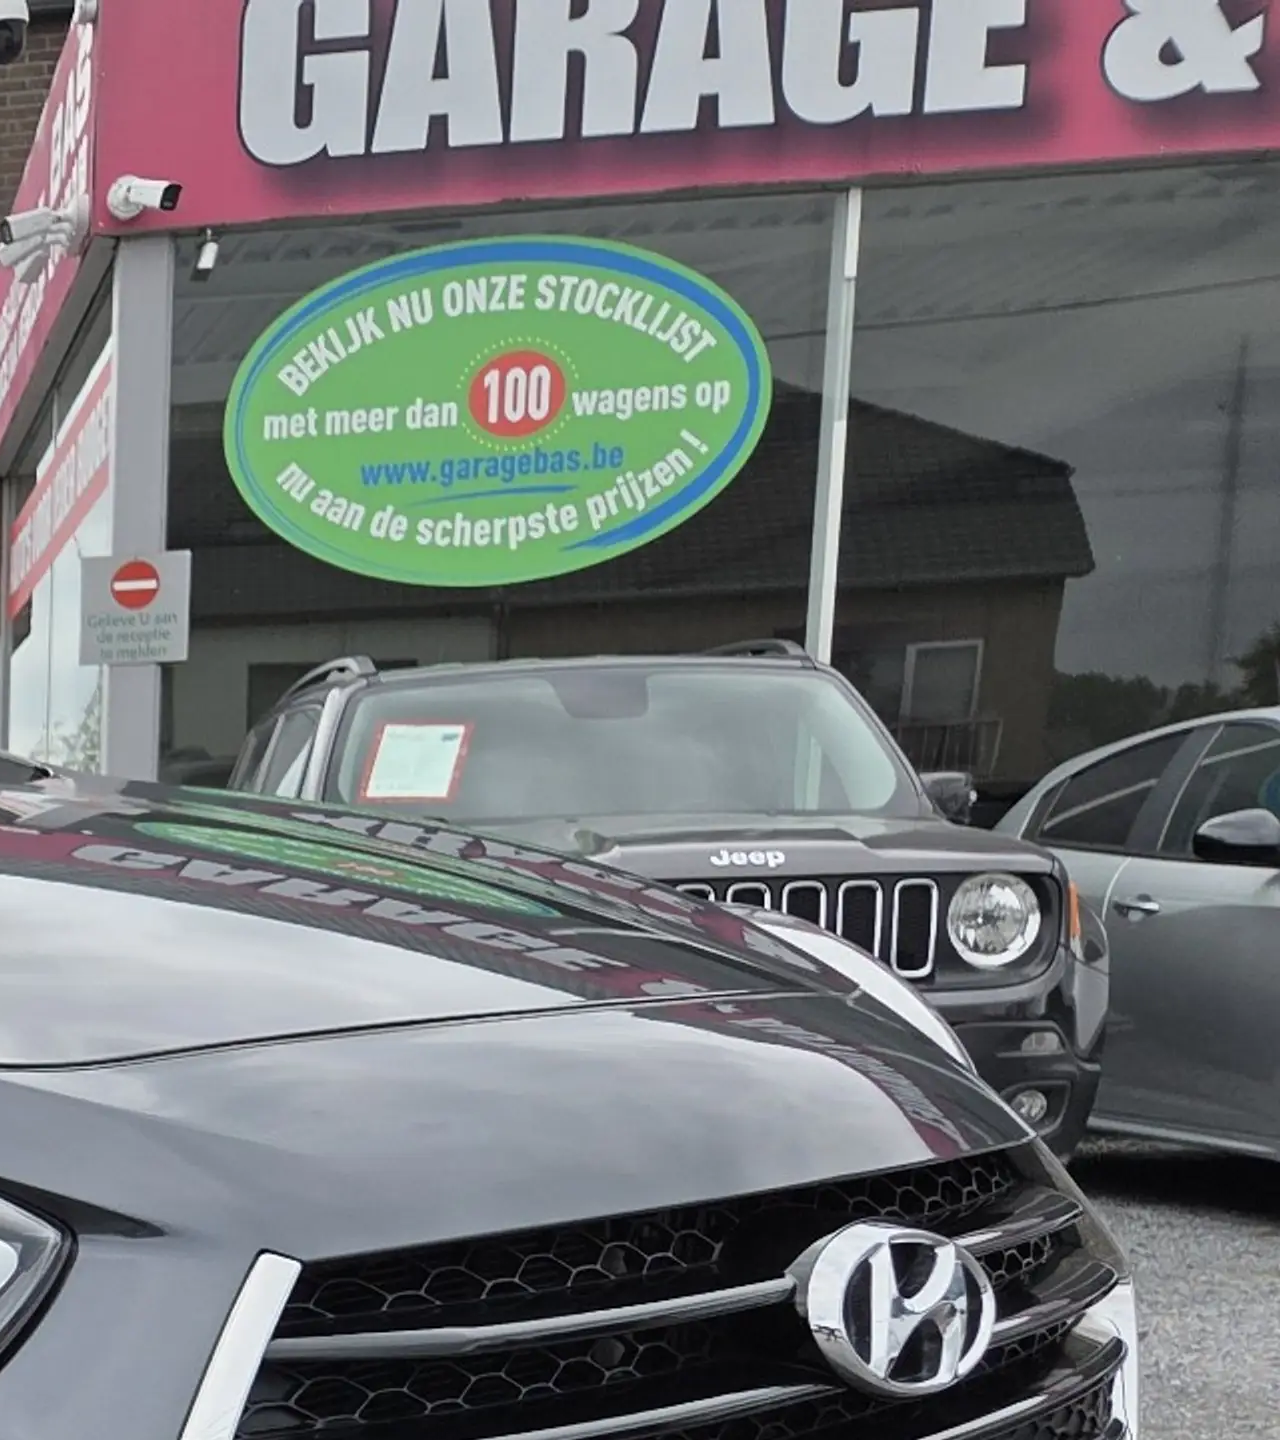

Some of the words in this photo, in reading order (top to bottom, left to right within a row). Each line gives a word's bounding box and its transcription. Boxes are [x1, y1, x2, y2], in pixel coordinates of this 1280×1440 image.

[238, 0, 1028, 166] GARAGE
[278, 306, 385, 397] BEKIJK
[387, 288, 434, 333] NU
[442, 274, 528, 317] ONZE
[534, 274, 718, 363] STOCKLIJST
[263, 406, 319, 441] met
[325, 404, 400, 436] meer
[406, 397, 458, 430] dan
[483, 365, 552, 424] 100
[571, 383, 688, 421] wagens
[695, 379, 731, 414] op
[276, 462, 316, 503] nu
[310, 488, 366, 531] aan
[369, 504, 409, 542] de
[415, 502, 579, 551] scherpste
[585, 446, 694, 531] prijzen
[360, 441, 625, 487] www.garagebas.be
[710, 849, 786, 868] Jeep
